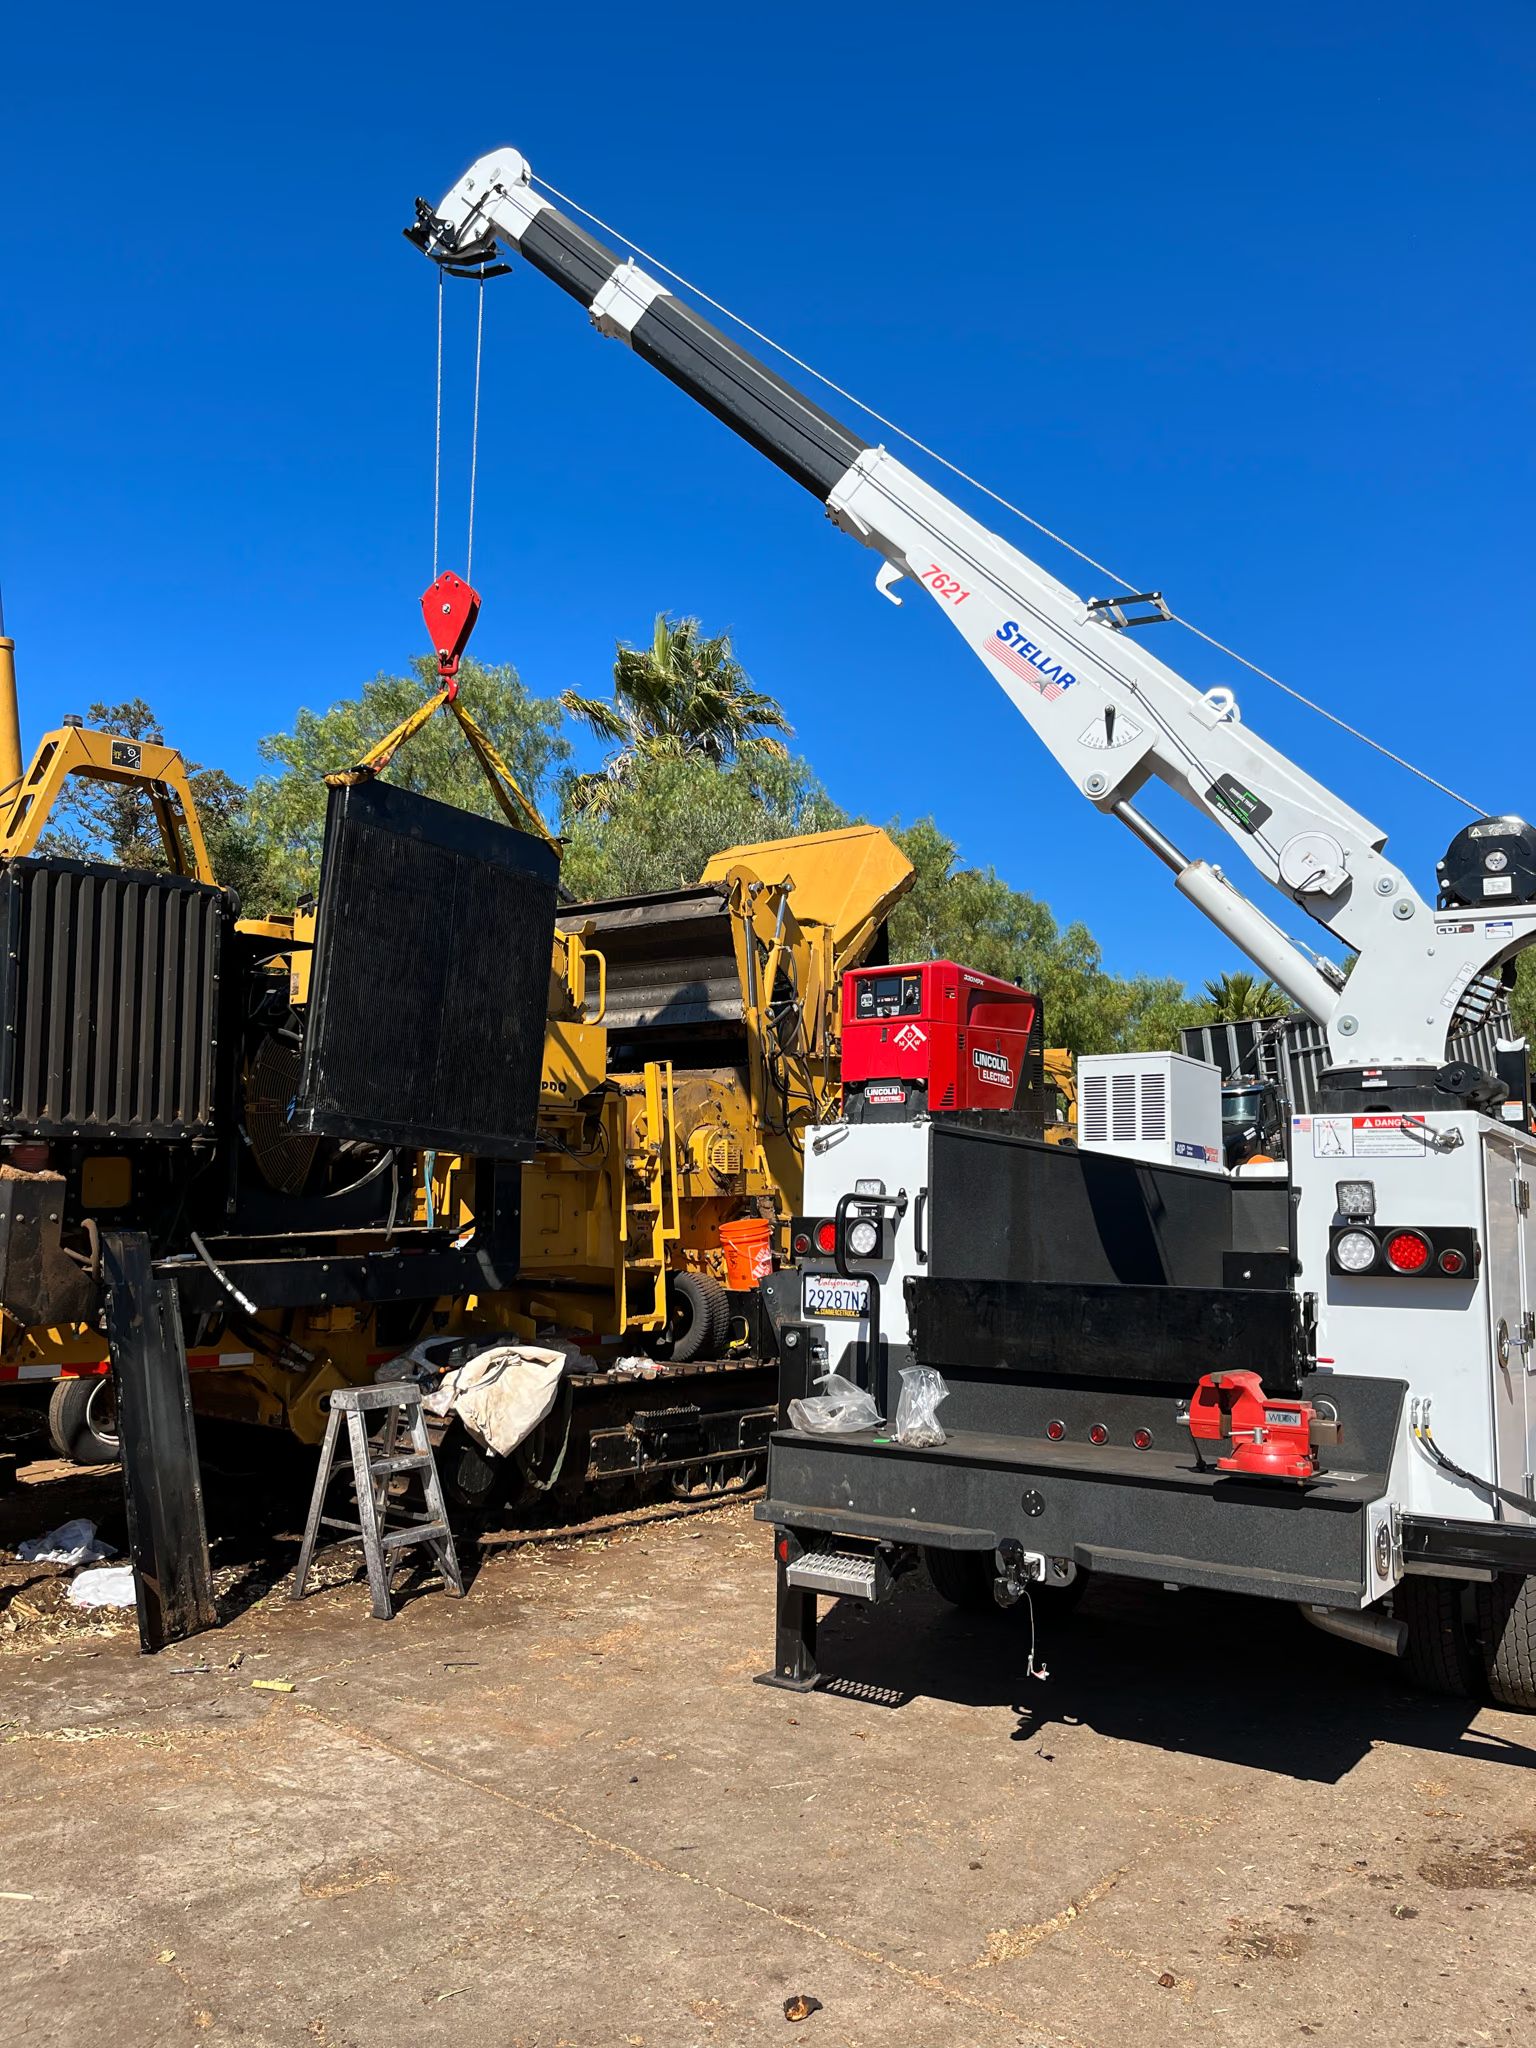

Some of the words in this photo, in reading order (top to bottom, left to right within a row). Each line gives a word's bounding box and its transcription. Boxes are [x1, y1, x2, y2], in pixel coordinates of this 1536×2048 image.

[921, 564, 971, 606] 7621
[996, 620, 1077, 690] STELLAR
[975, 1052, 1007, 1072] LINCOLN
[982, 1069, 1010, 1085] ELECTRIC
[866, 1088, 898, 1096] LINCOLN
[809, 1288, 868, 1311] 29287N3
[1269, 1414, 1297, 1424] WILTON
